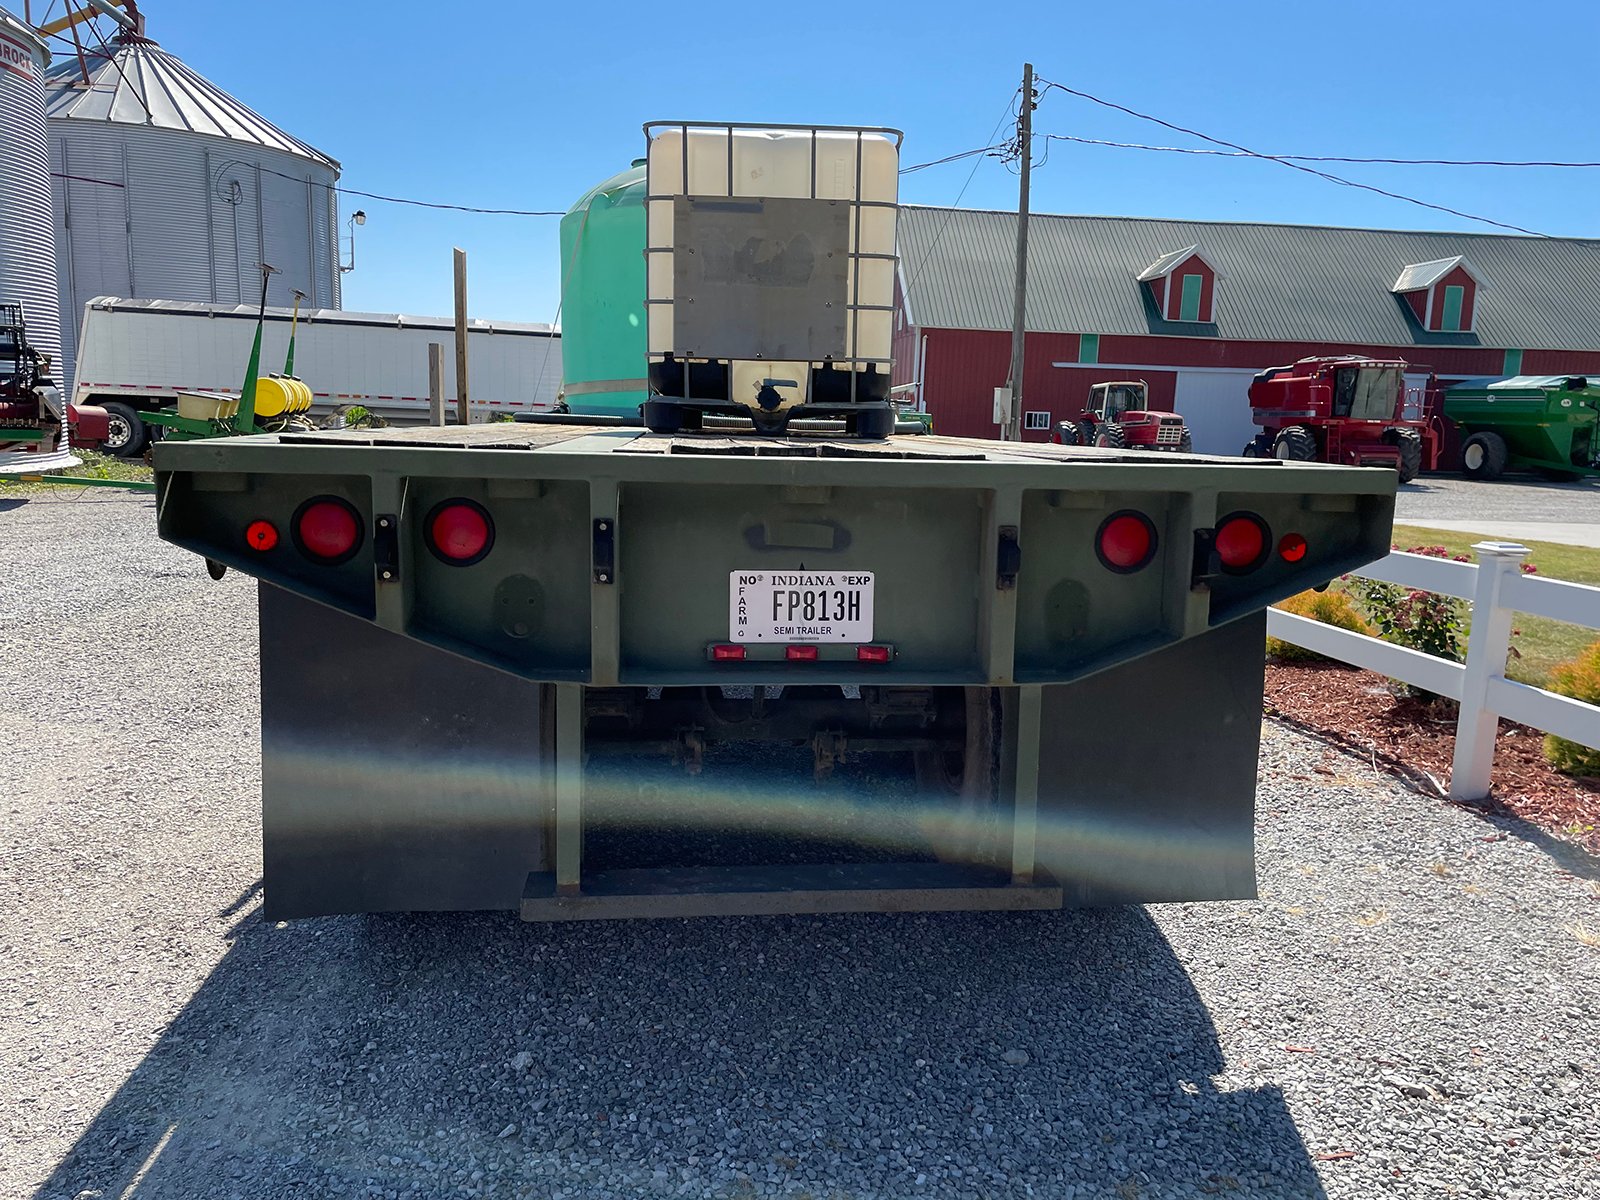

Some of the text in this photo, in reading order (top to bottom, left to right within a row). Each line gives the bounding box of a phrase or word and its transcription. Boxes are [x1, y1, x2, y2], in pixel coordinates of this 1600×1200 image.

[739, 575, 757, 585] NO
[771, 575, 836, 586] INDIANA
[847, 576, 871, 586] EXP
[738, 586, 748, 625] FARM
[772, 590, 860, 622] FP813H
[774, 626, 832, 635] SEMI TRAILER
